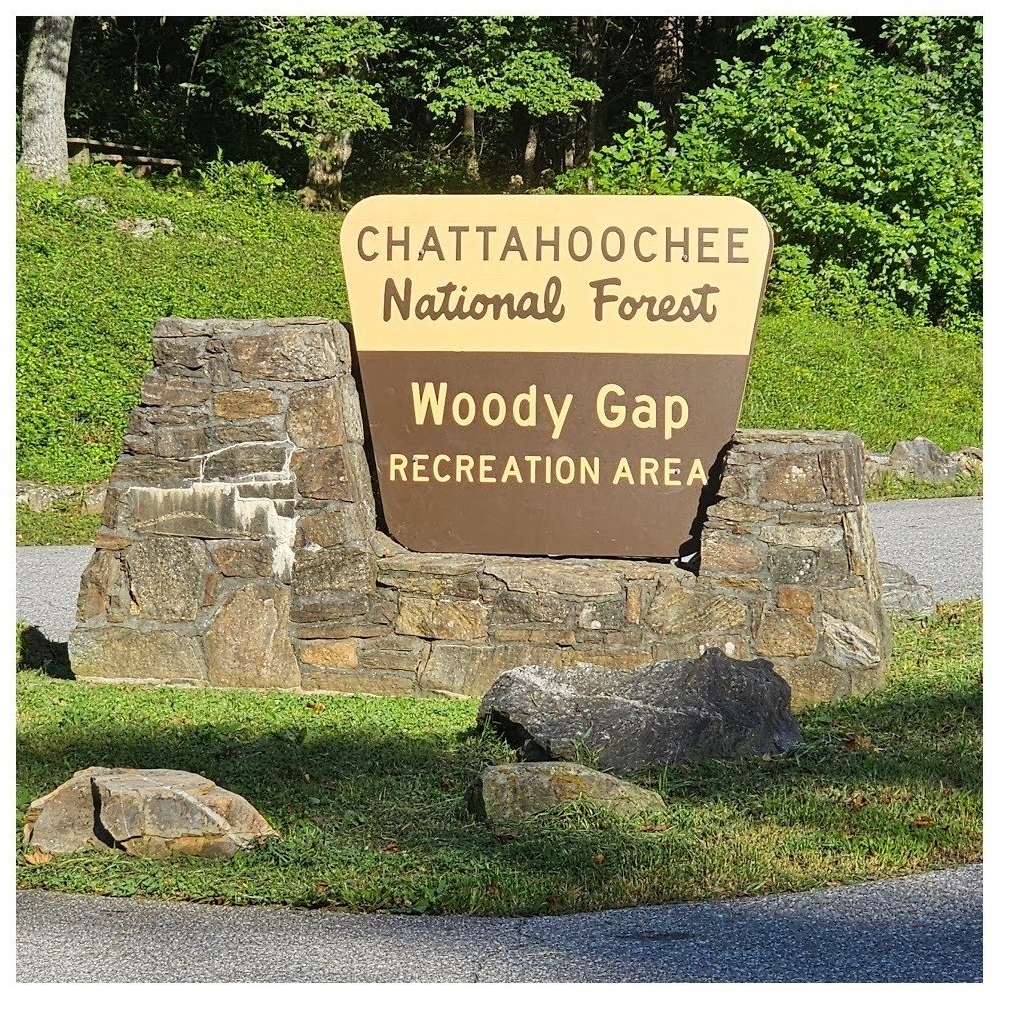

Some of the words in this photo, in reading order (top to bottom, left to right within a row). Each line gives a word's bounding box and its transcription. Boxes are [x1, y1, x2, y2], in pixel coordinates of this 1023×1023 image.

[356, 225, 749, 264] CHATTAHOOCHEE
[382, 275, 566, 323] National
[589, 277, 720, 323] Forest
[411, 382, 574, 440] Woody
[596, 383, 689, 440] Gap
[389, 453, 600, 485] RECREATION
[612, 457, 709, 486] AREA
